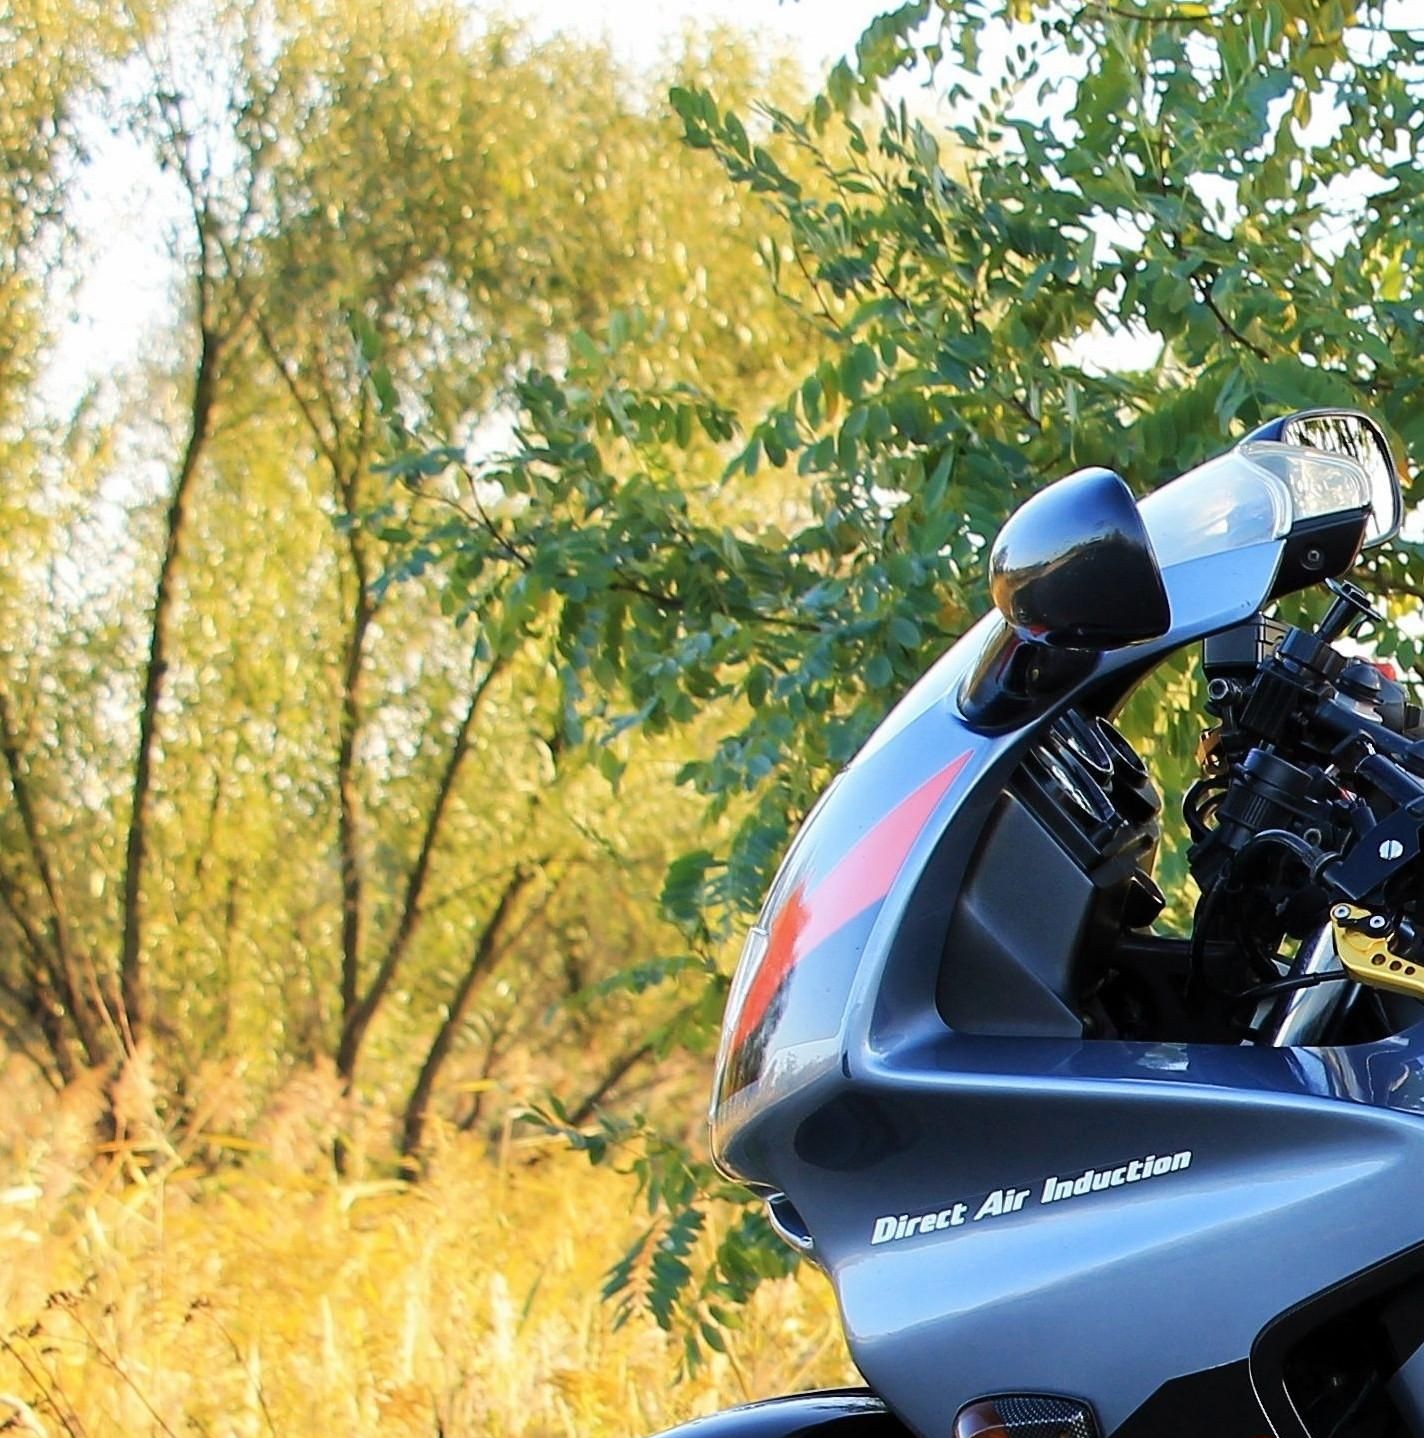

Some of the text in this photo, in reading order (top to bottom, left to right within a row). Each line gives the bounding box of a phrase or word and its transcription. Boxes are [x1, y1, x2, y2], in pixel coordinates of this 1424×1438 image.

[871, 1149, 1193, 1245] Direct Air Induction
